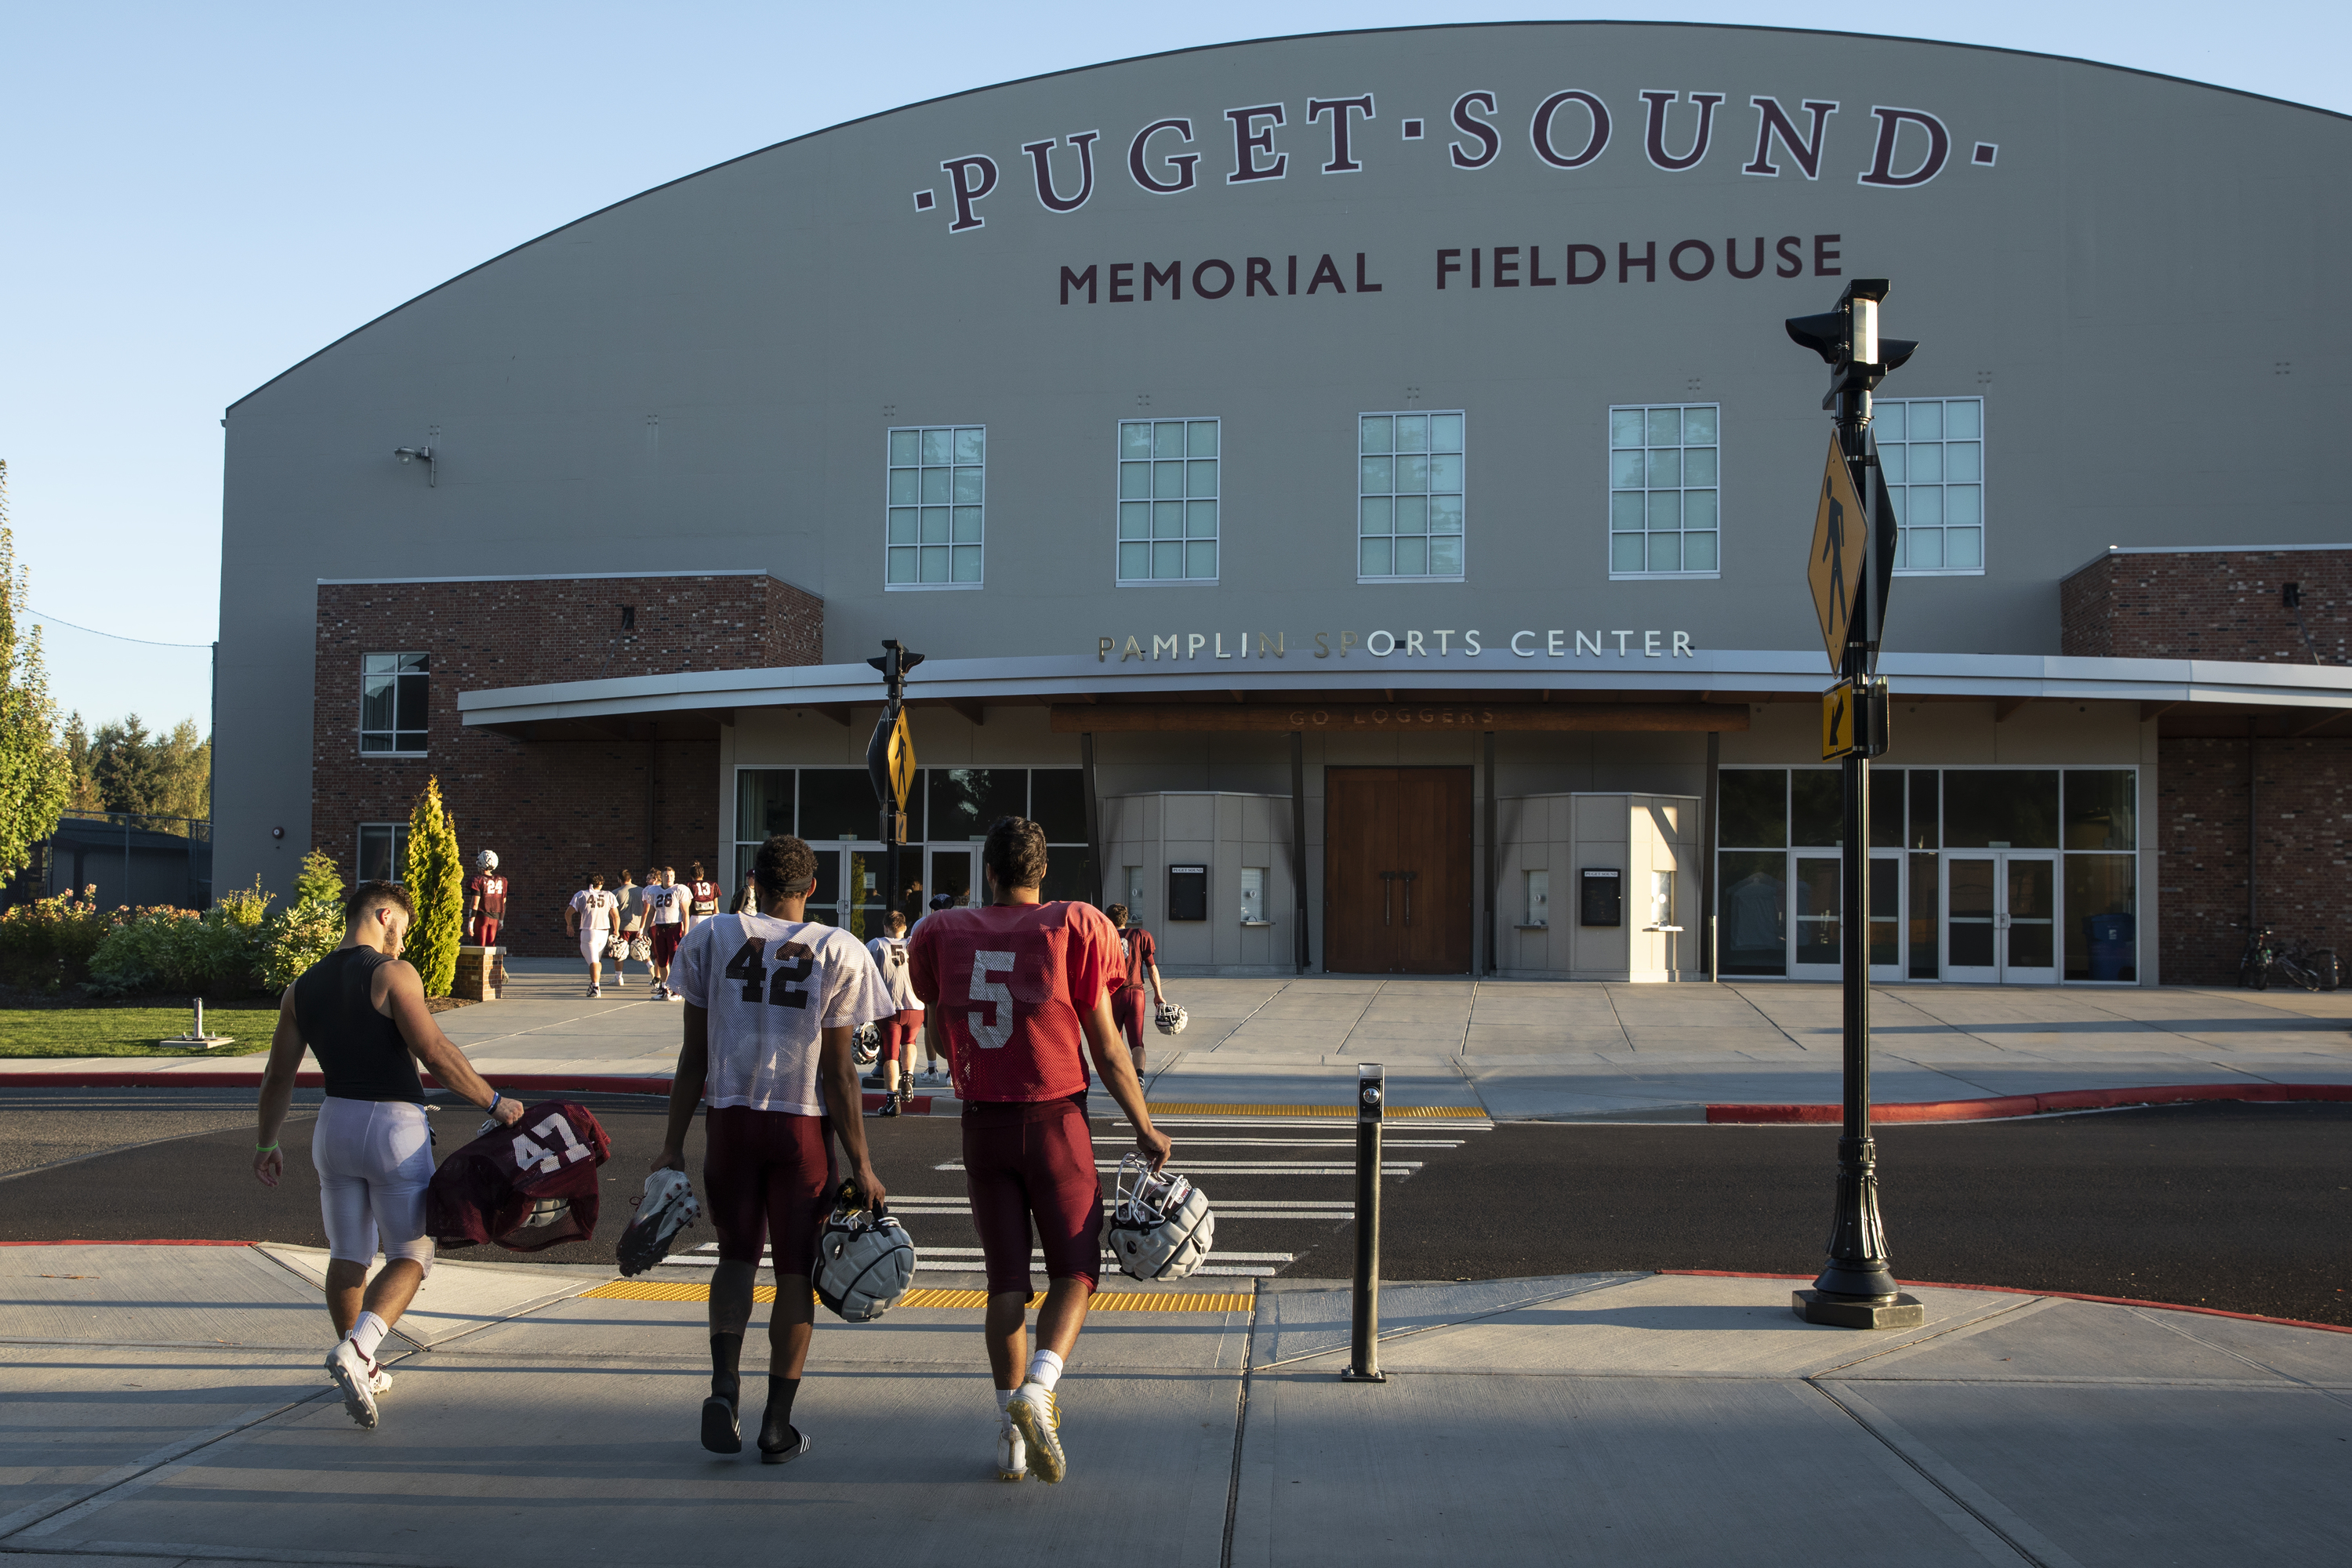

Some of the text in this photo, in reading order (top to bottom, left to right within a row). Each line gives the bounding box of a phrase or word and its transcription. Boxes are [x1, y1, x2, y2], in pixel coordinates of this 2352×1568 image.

[939, 89, 1951, 234] PUGET SOUND
[1060, 234, 1842, 305] MEMORIAL FIELDHOUSE
[1098, 630, 1693, 662] PAMPLIN SPORTS CENTER
[1290, 708, 1493, 725] GO LOGGERS
[486, 879, 503, 894] 24
[656, 893, 673, 907] 26
[695, 882, 711, 896] 13
[725, 936, 815, 1010] 42
[968, 949, 1016, 1049] 5
[512, 1112, 591, 1174] 47
